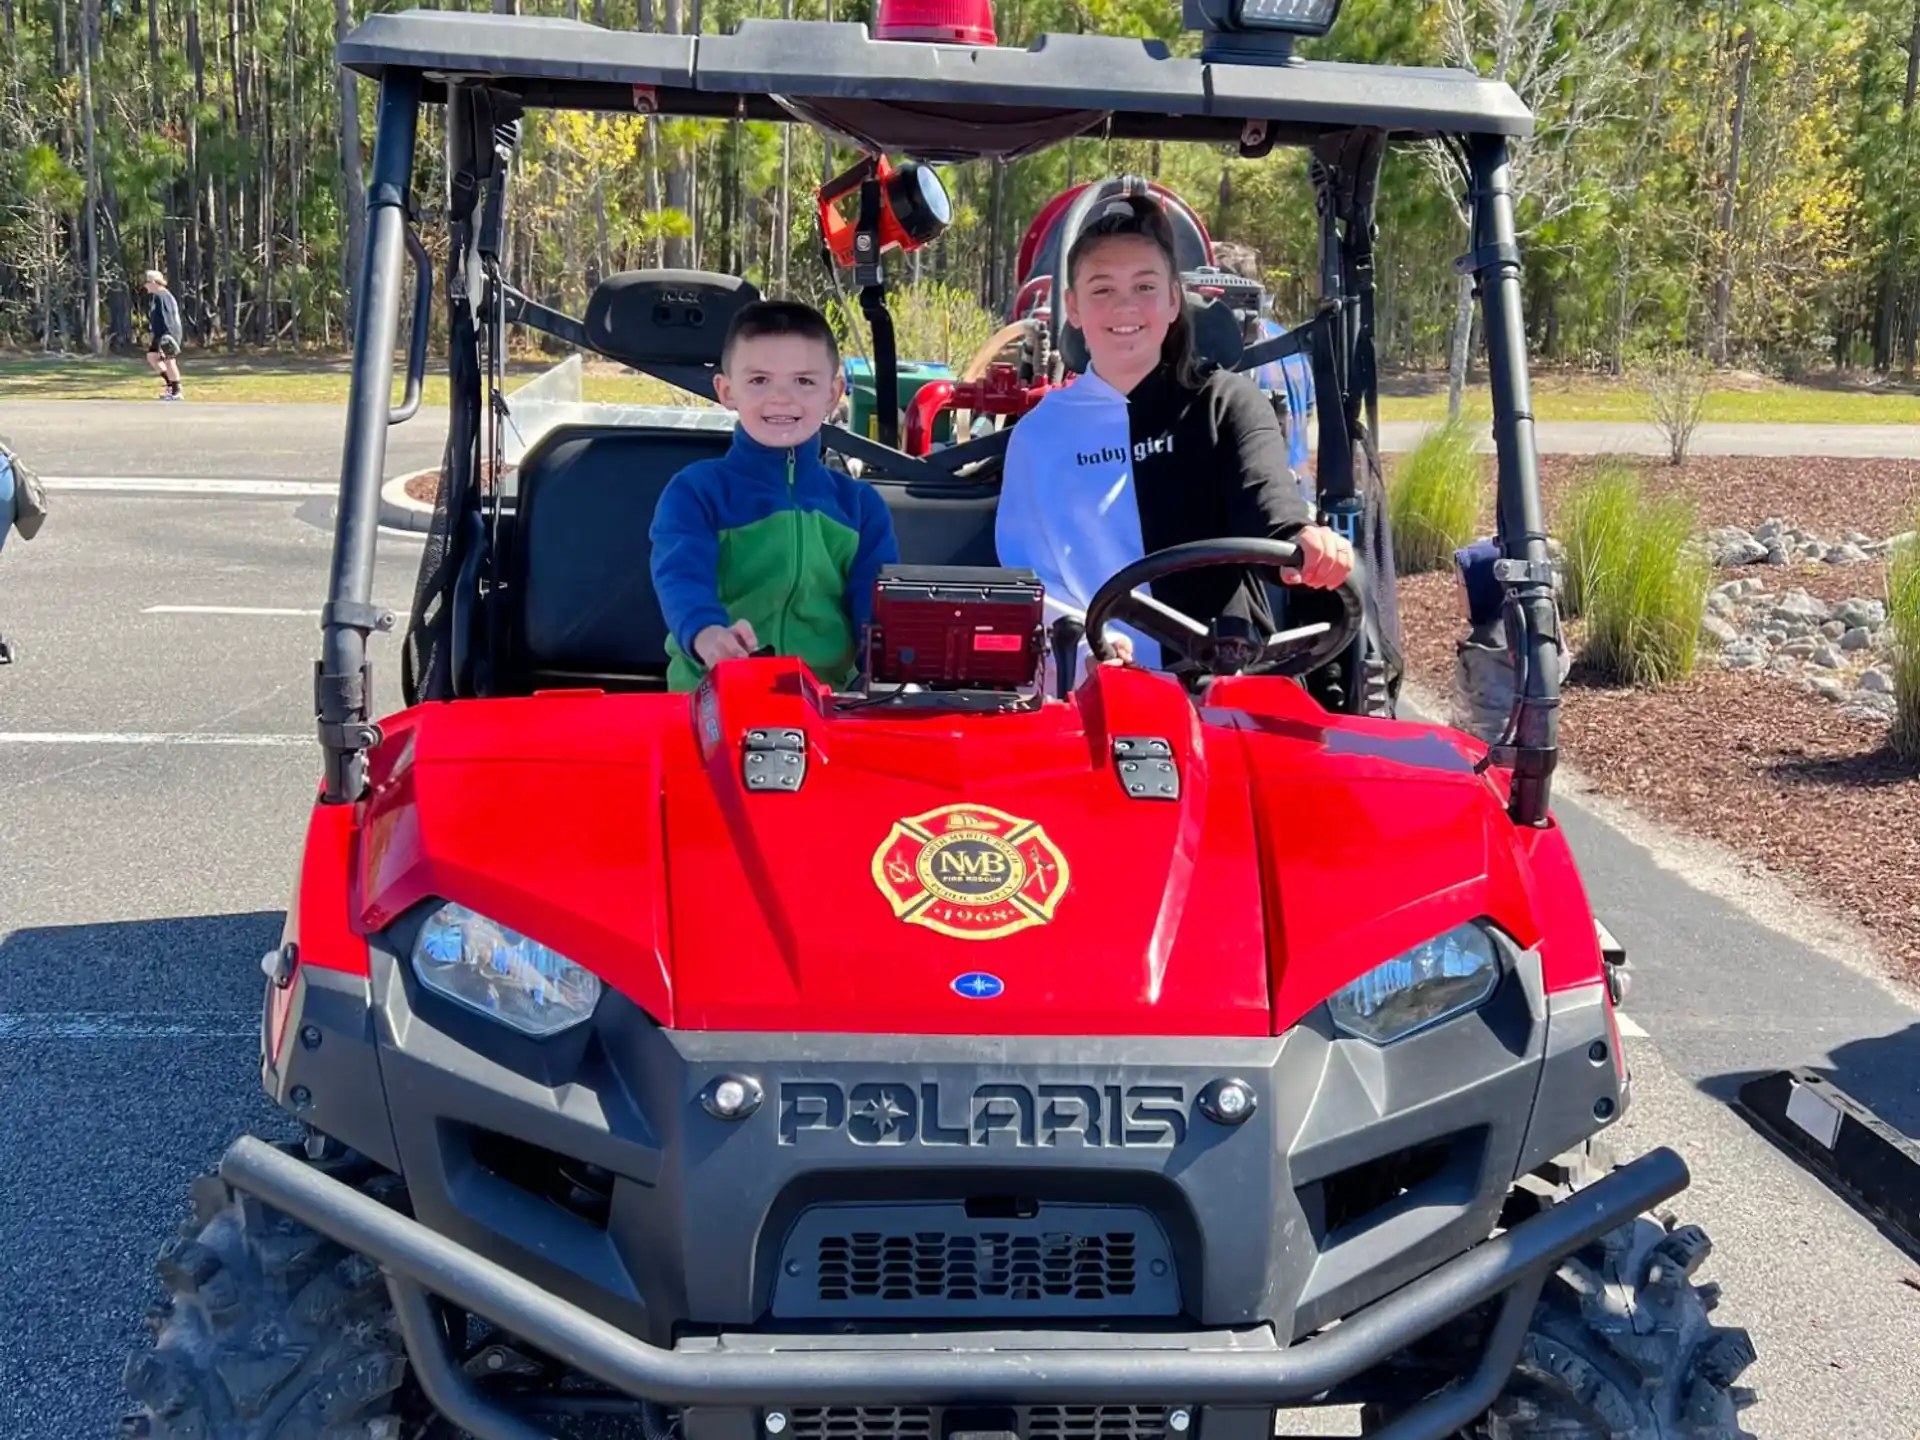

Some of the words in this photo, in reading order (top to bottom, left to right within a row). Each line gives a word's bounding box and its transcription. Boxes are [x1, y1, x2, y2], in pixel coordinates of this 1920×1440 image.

[1077, 448, 1126, 465] baby
[1134, 435, 1173, 461] girl
[778, 1082, 1188, 1147] POLARIS
